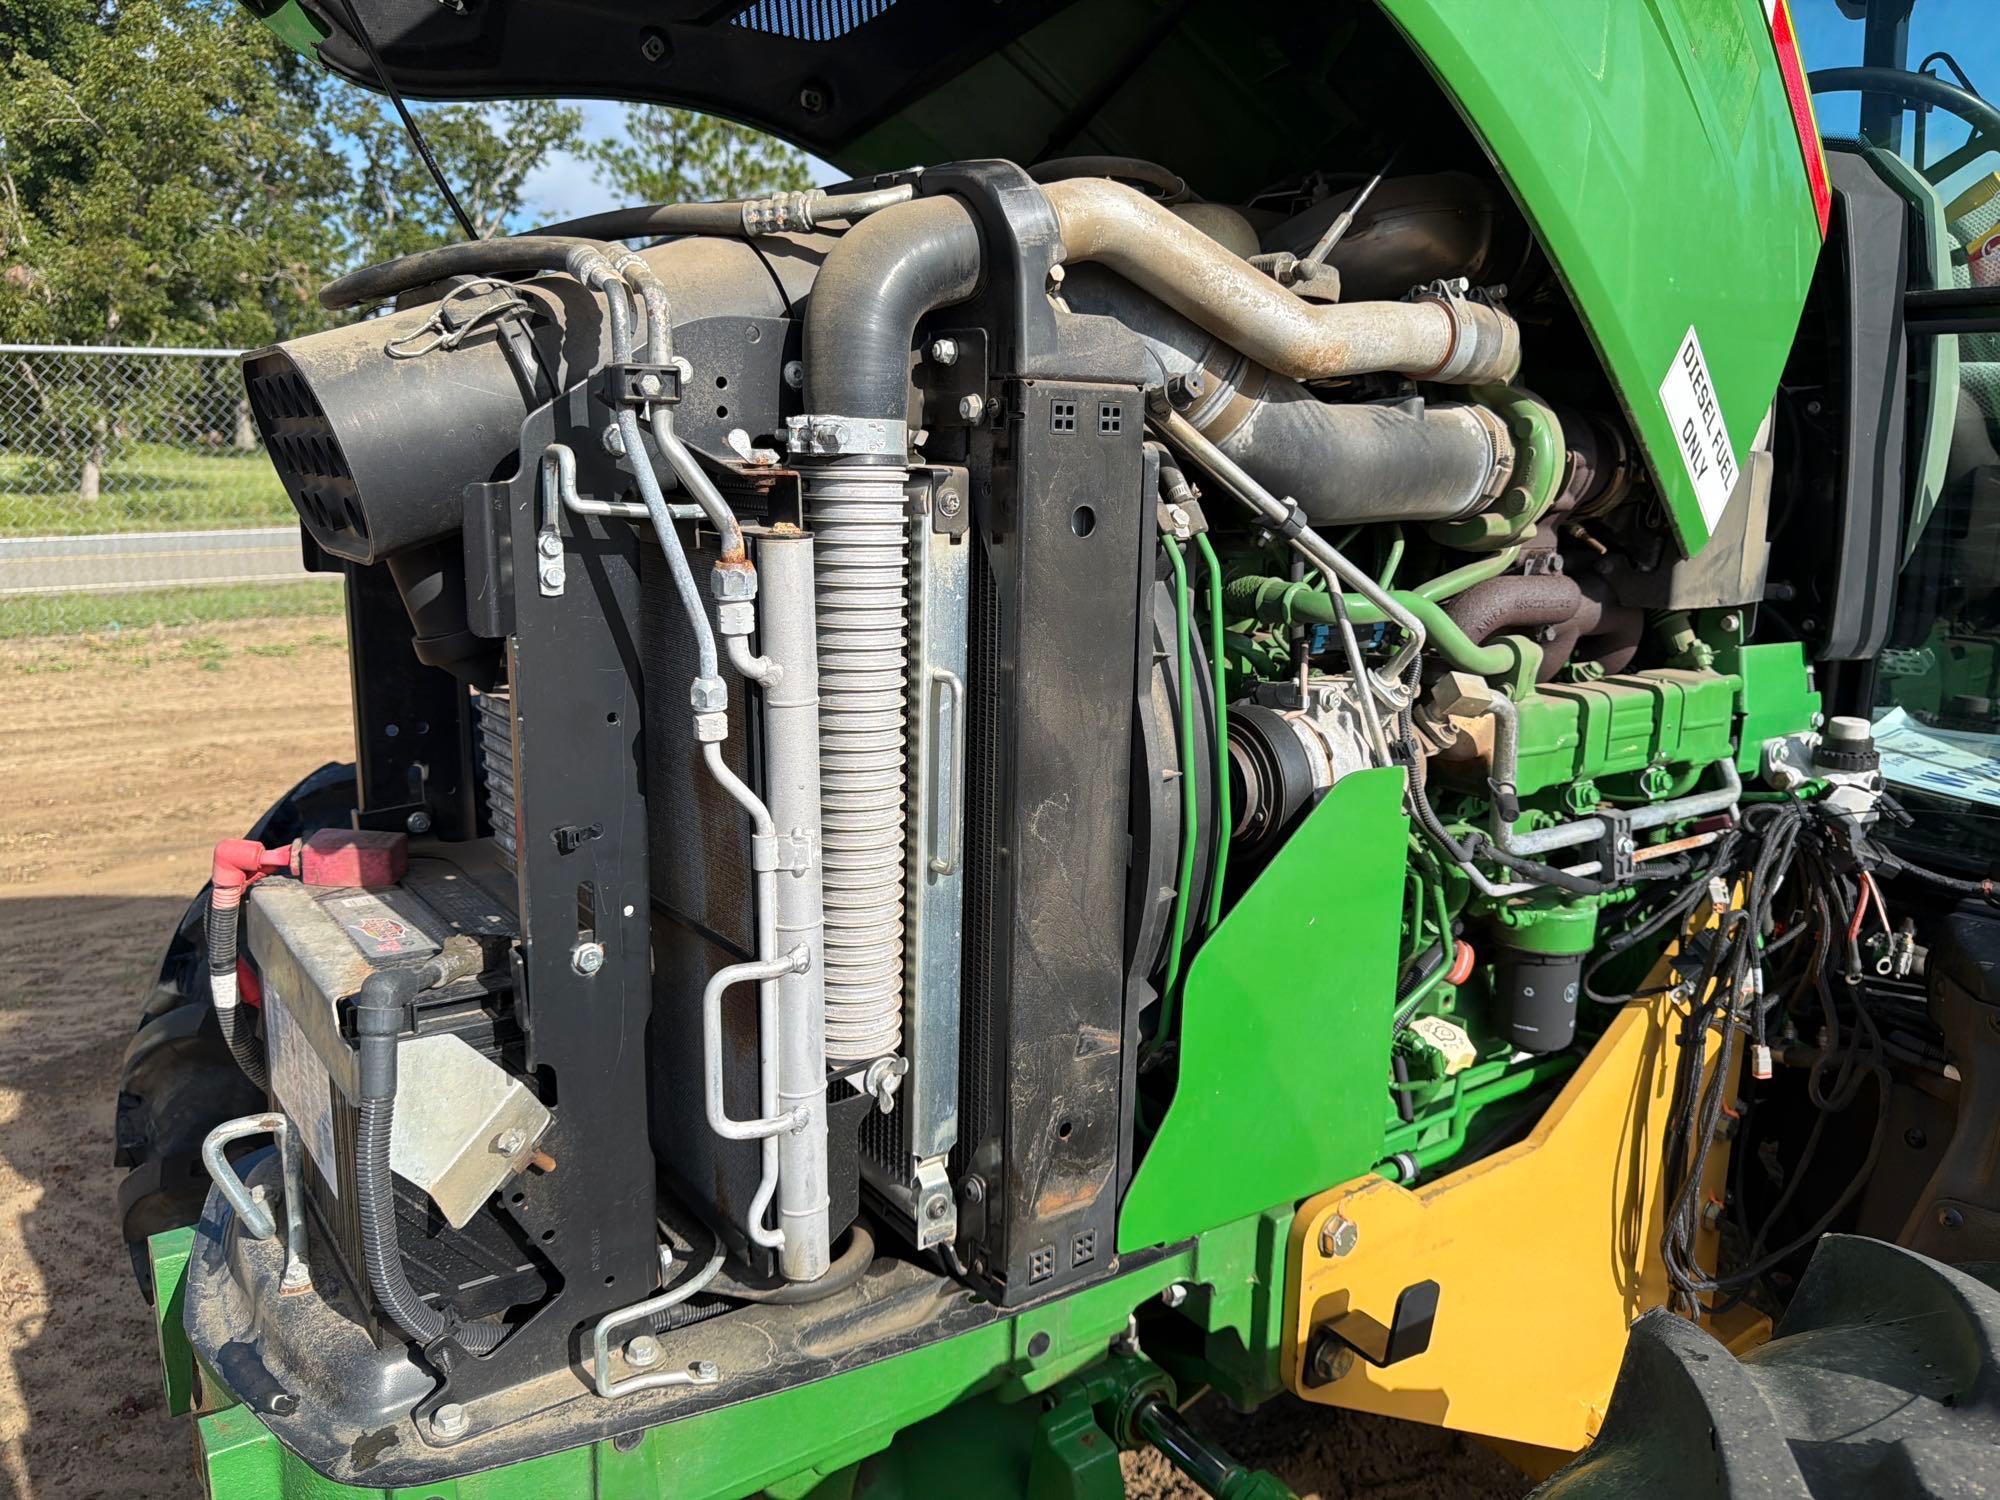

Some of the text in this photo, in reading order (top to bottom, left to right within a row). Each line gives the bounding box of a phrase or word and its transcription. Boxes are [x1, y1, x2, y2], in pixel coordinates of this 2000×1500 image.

[1683, 341, 1733, 491] DIESEL FUEL
[1683, 418, 1708, 480] ONLY
